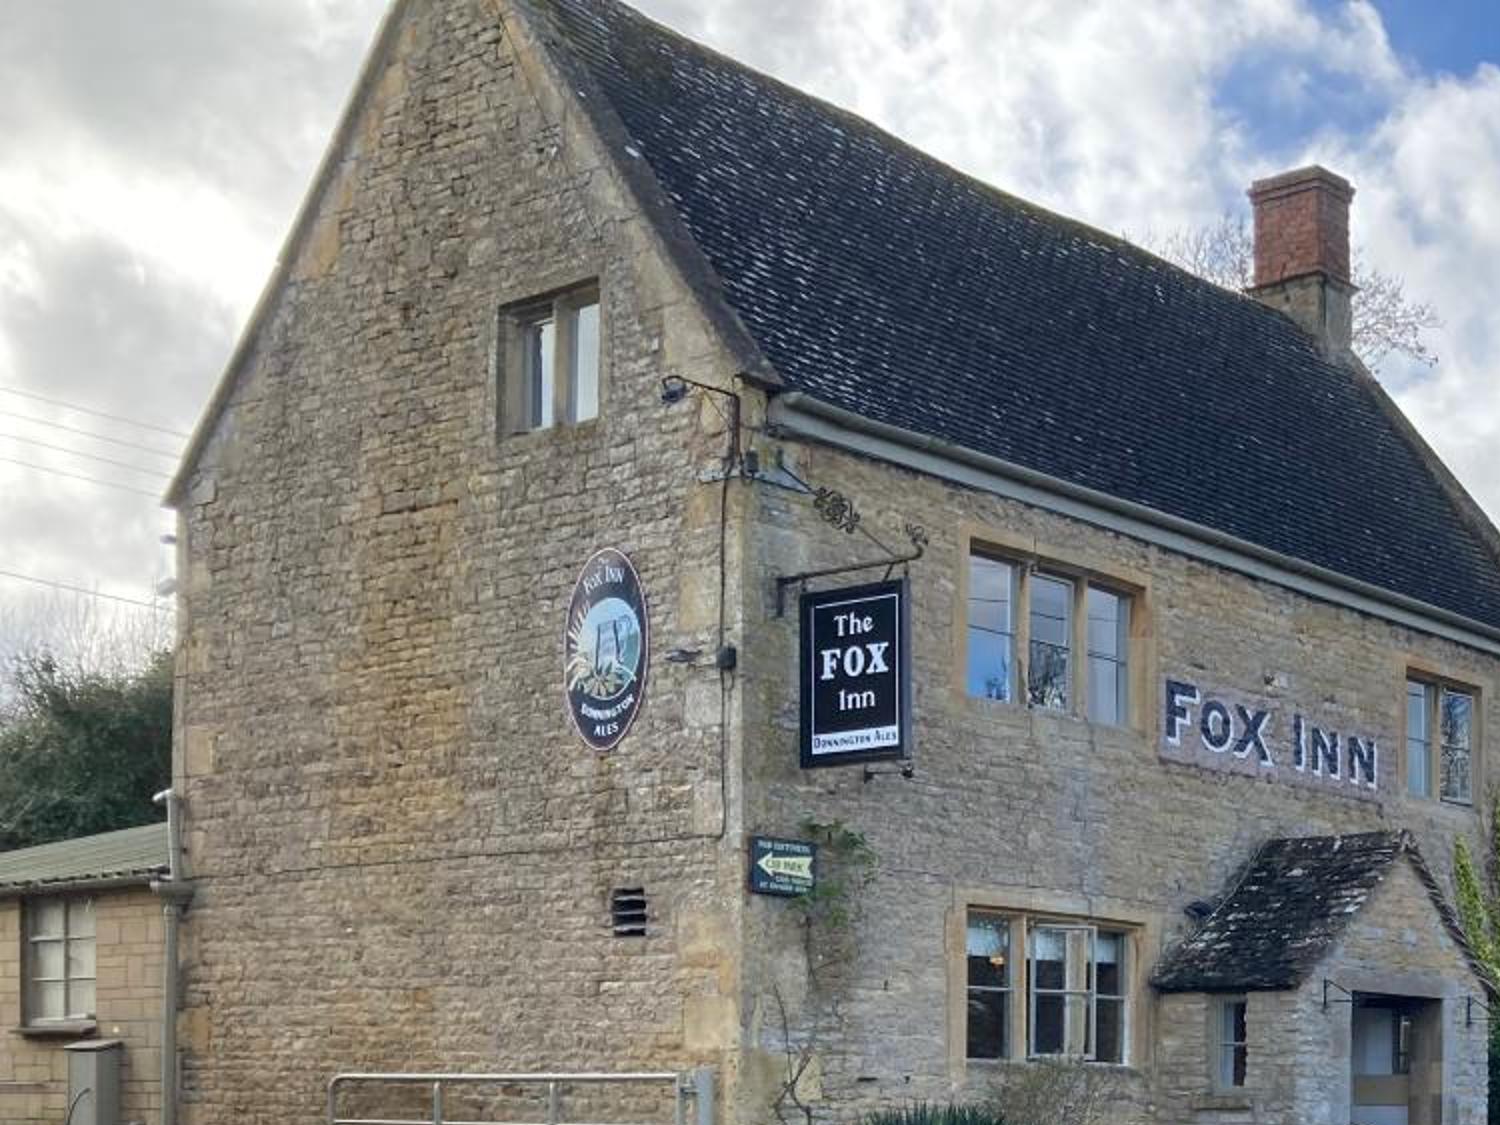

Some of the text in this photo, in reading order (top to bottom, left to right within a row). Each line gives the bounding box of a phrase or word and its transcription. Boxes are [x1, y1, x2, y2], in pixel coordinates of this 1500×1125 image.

[605, 565, 625, 583] INN
[833, 611, 875, 637] The
[820, 641, 889, 680] FOX
[838, 688, 876, 711] Inn
[593, 721, 619, 737] ALES
[1165, 679, 1378, 790] FOX INN
